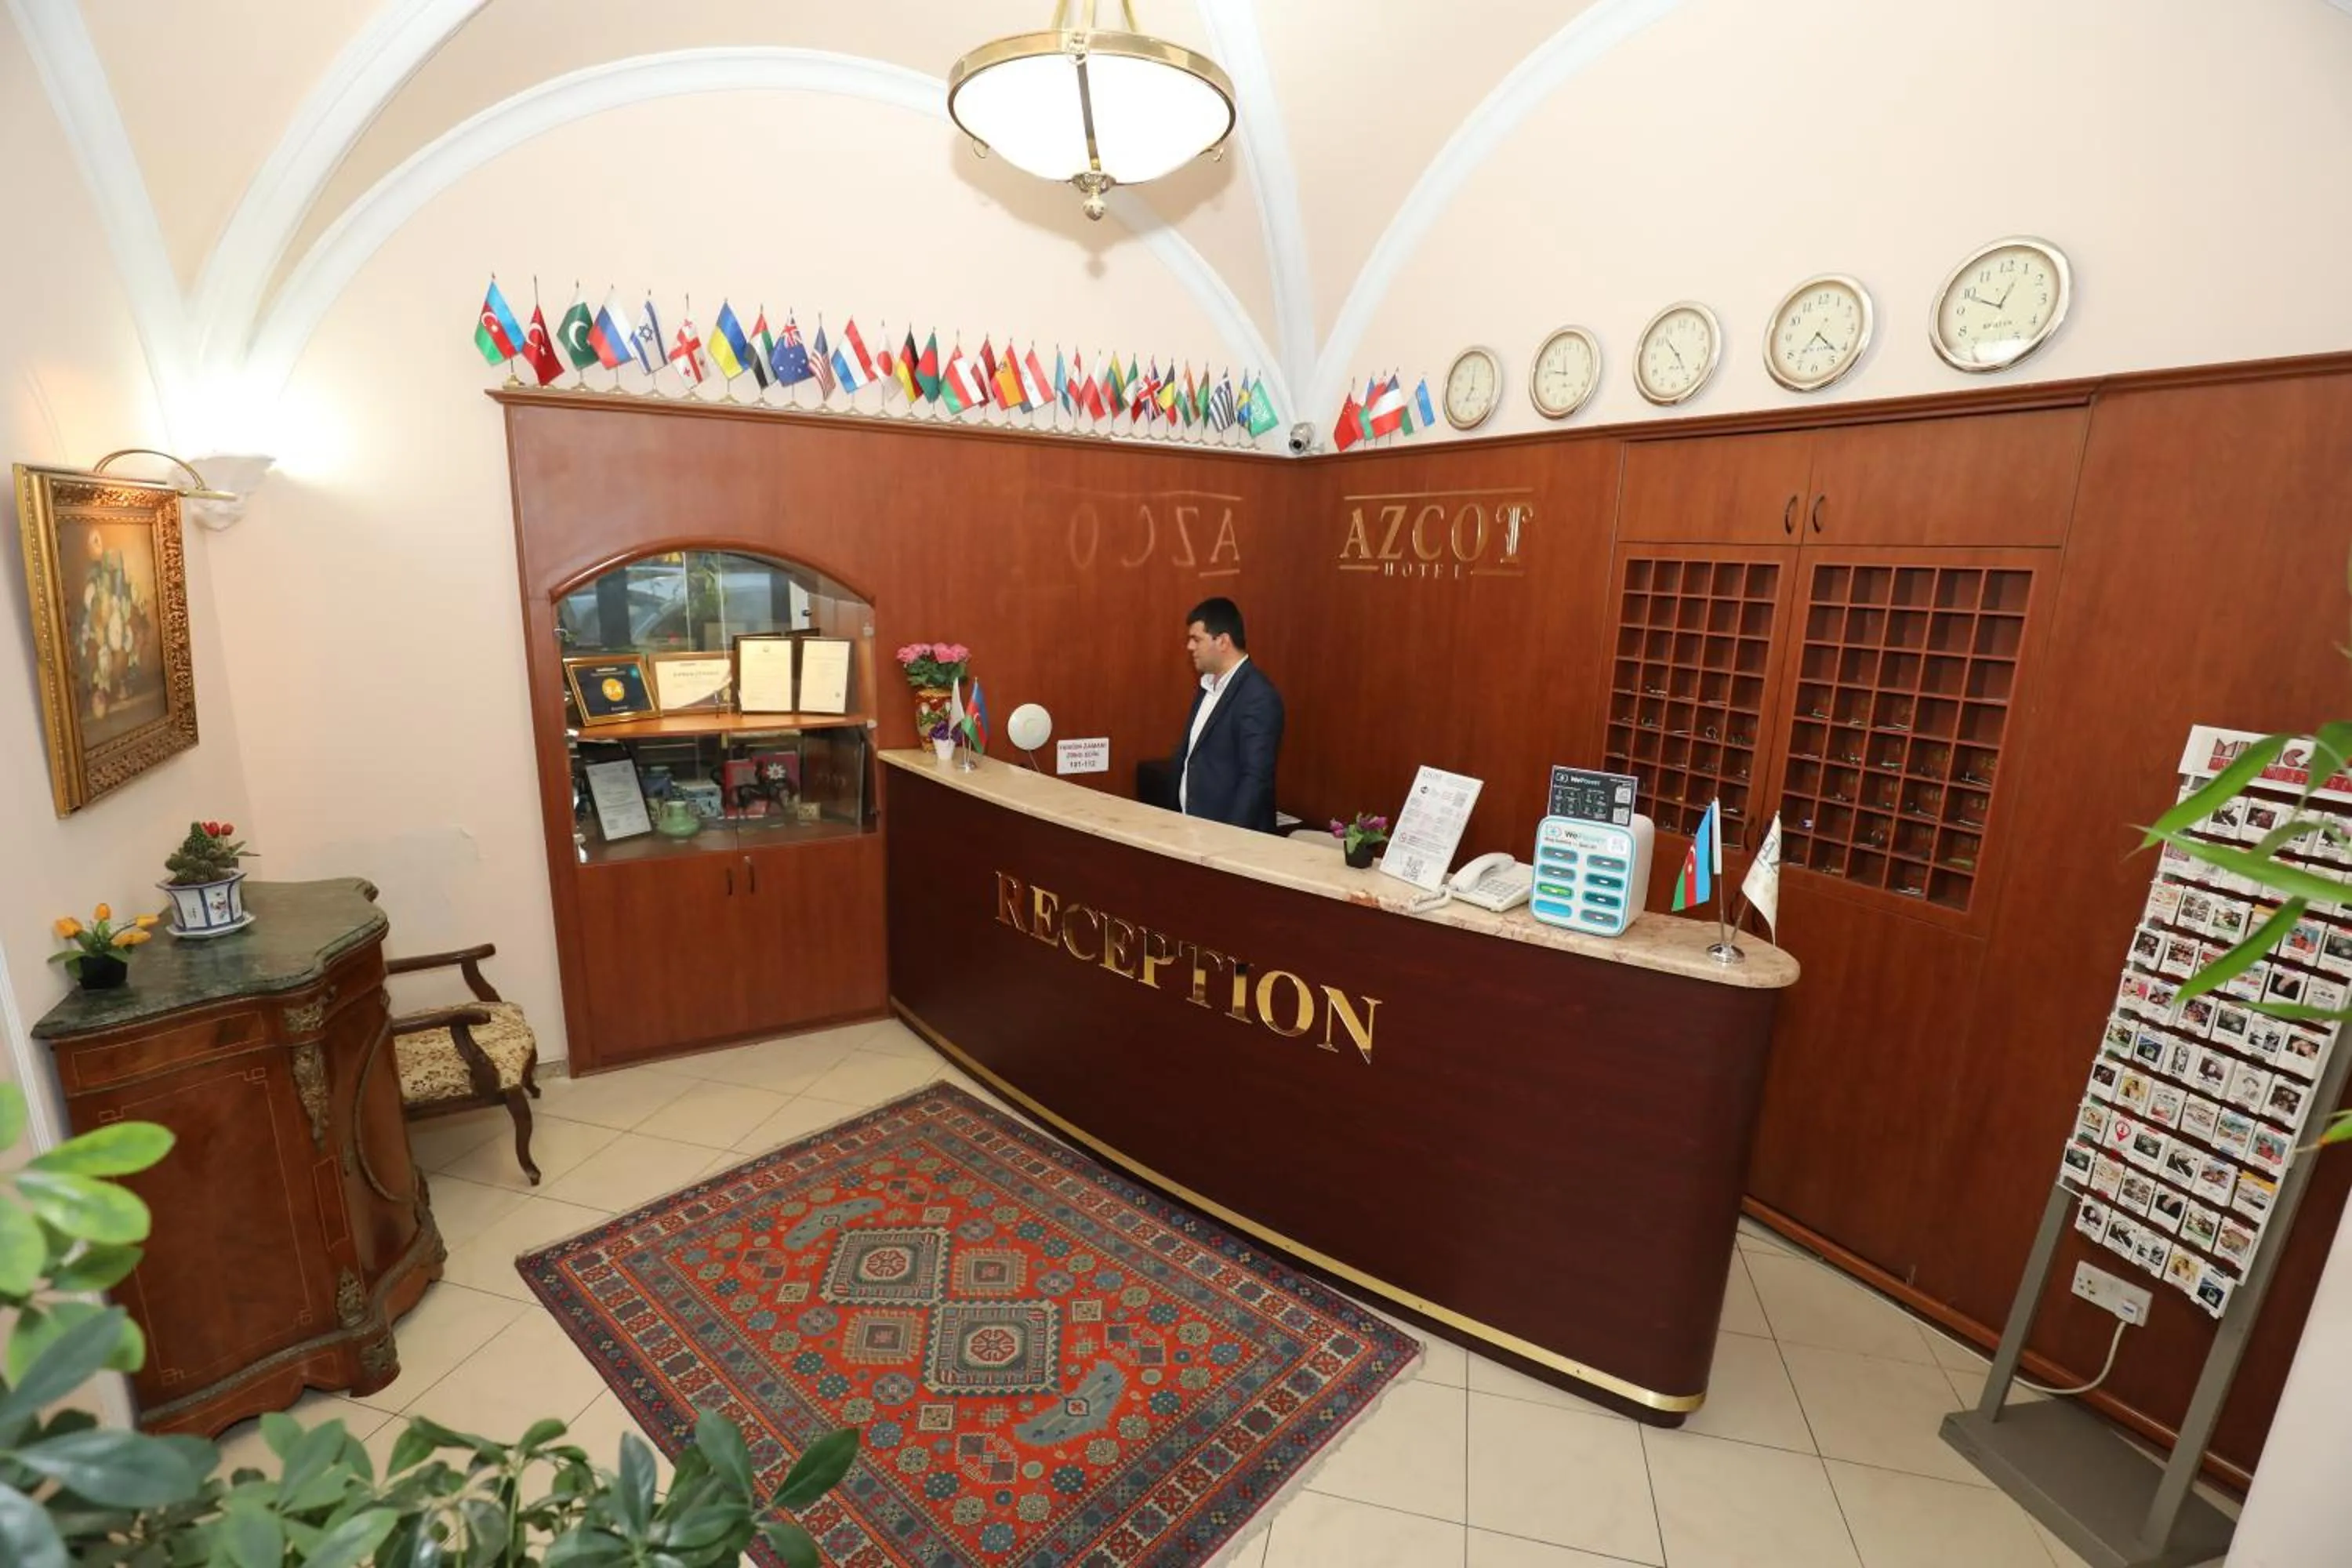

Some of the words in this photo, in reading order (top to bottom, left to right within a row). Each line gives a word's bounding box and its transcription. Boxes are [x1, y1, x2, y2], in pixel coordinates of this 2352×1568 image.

[1980, 270, 1991, 283] 11
[1339, 503, 1534, 564] AZCOT
[1384, 562, 1461, 579] HOTEL
[995, 870, 1384, 1065] RECEPTION
